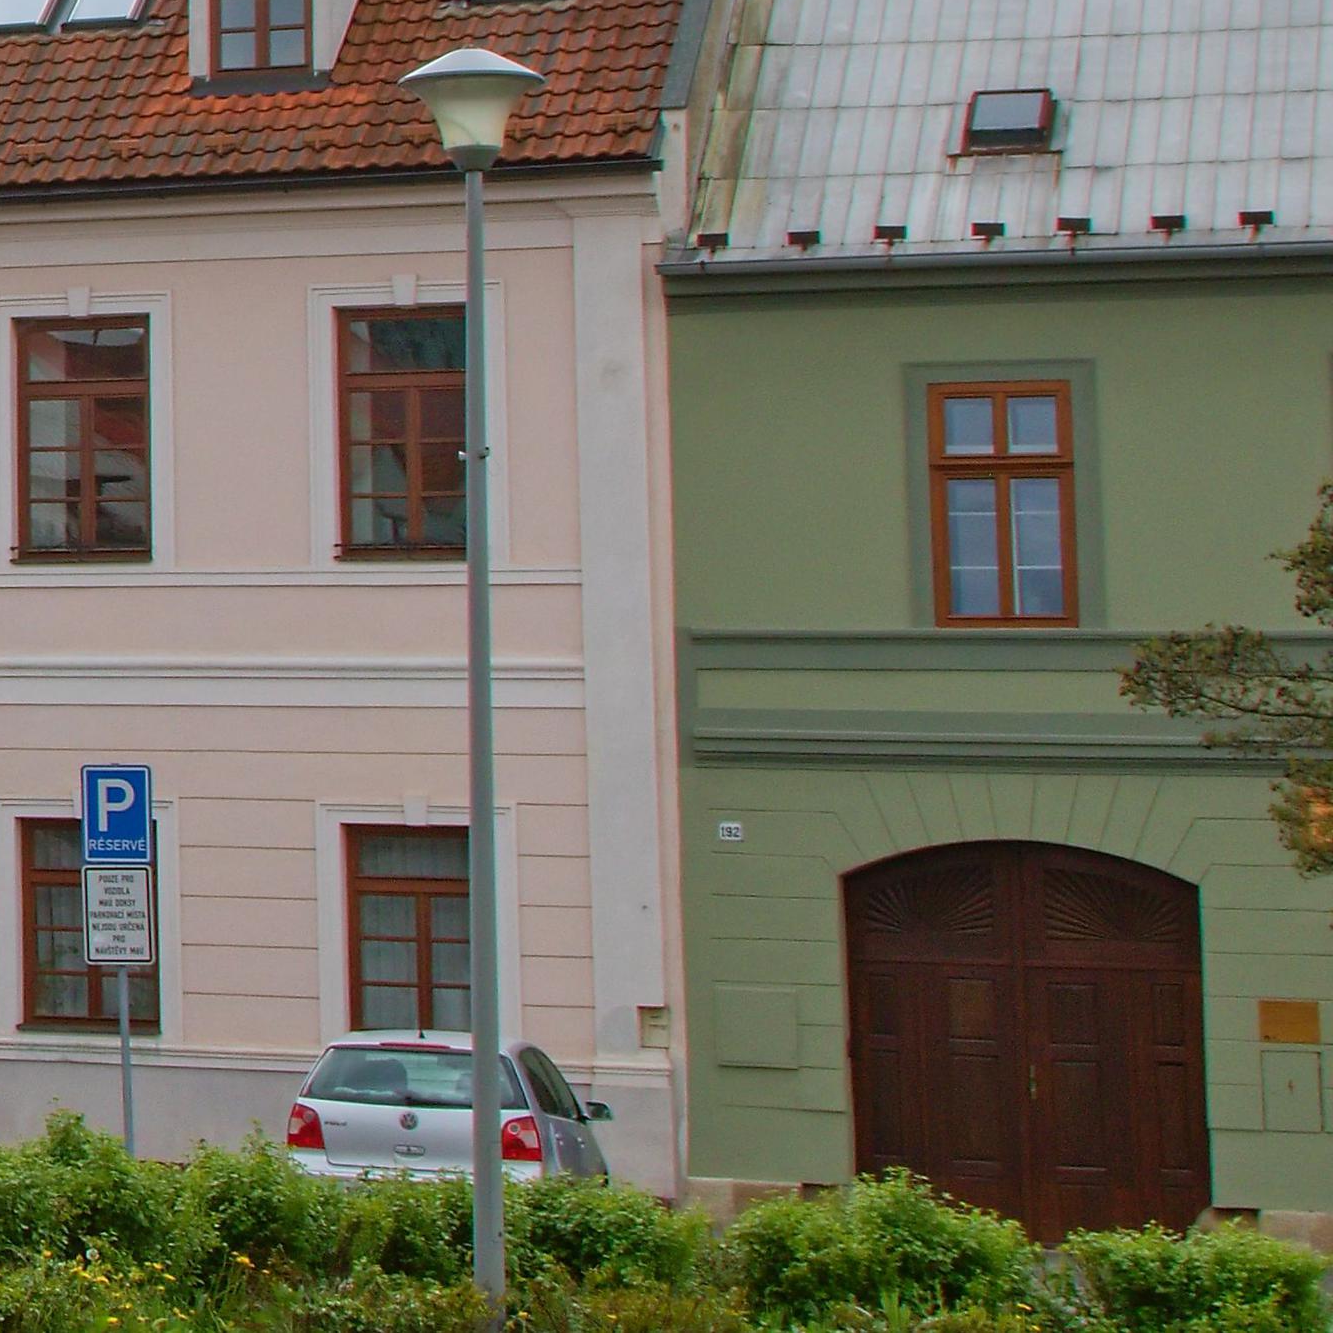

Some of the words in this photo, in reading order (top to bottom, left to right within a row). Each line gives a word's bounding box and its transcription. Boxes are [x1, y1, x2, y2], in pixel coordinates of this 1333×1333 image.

[98, 778, 135, 832] P
[721, 826, 740, 837] 192
[89, 837, 147, 851] RÉSERVÉ
